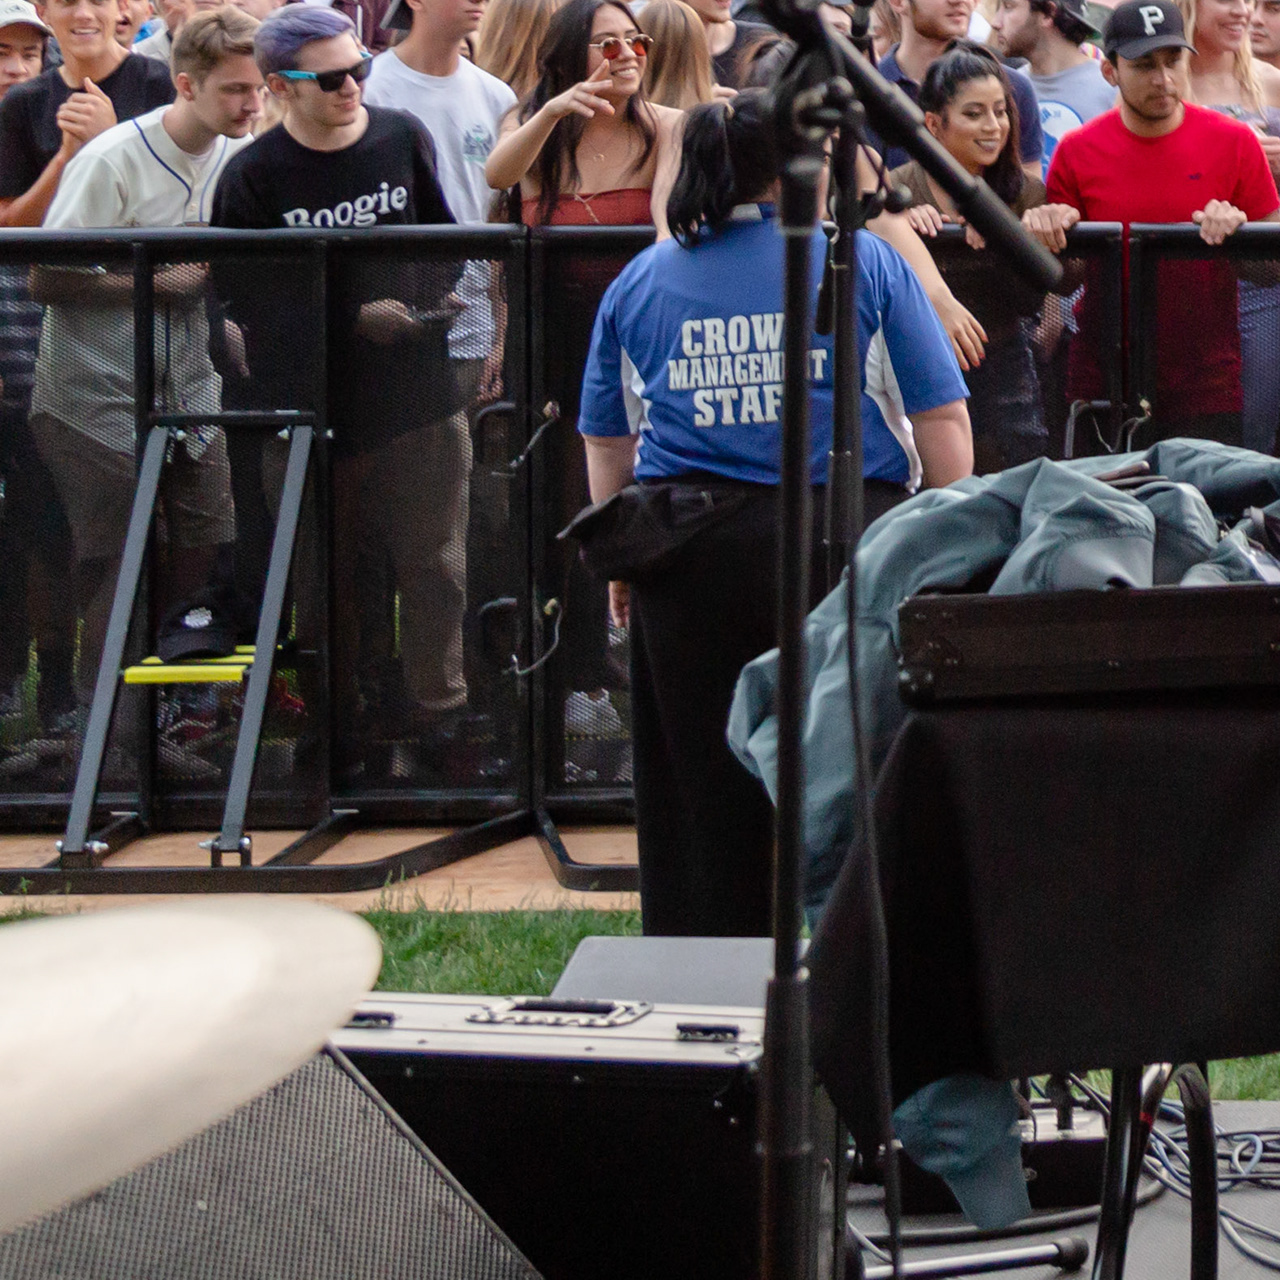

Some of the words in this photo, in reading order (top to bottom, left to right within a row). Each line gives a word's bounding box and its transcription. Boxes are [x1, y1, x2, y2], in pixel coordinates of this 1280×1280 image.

[1139, 6, 1165, 36] P
[682, 313, 785, 358] CROW
[668, 349, 827, 390] MANAGEMT
[694, 384, 783, 427] STAF
